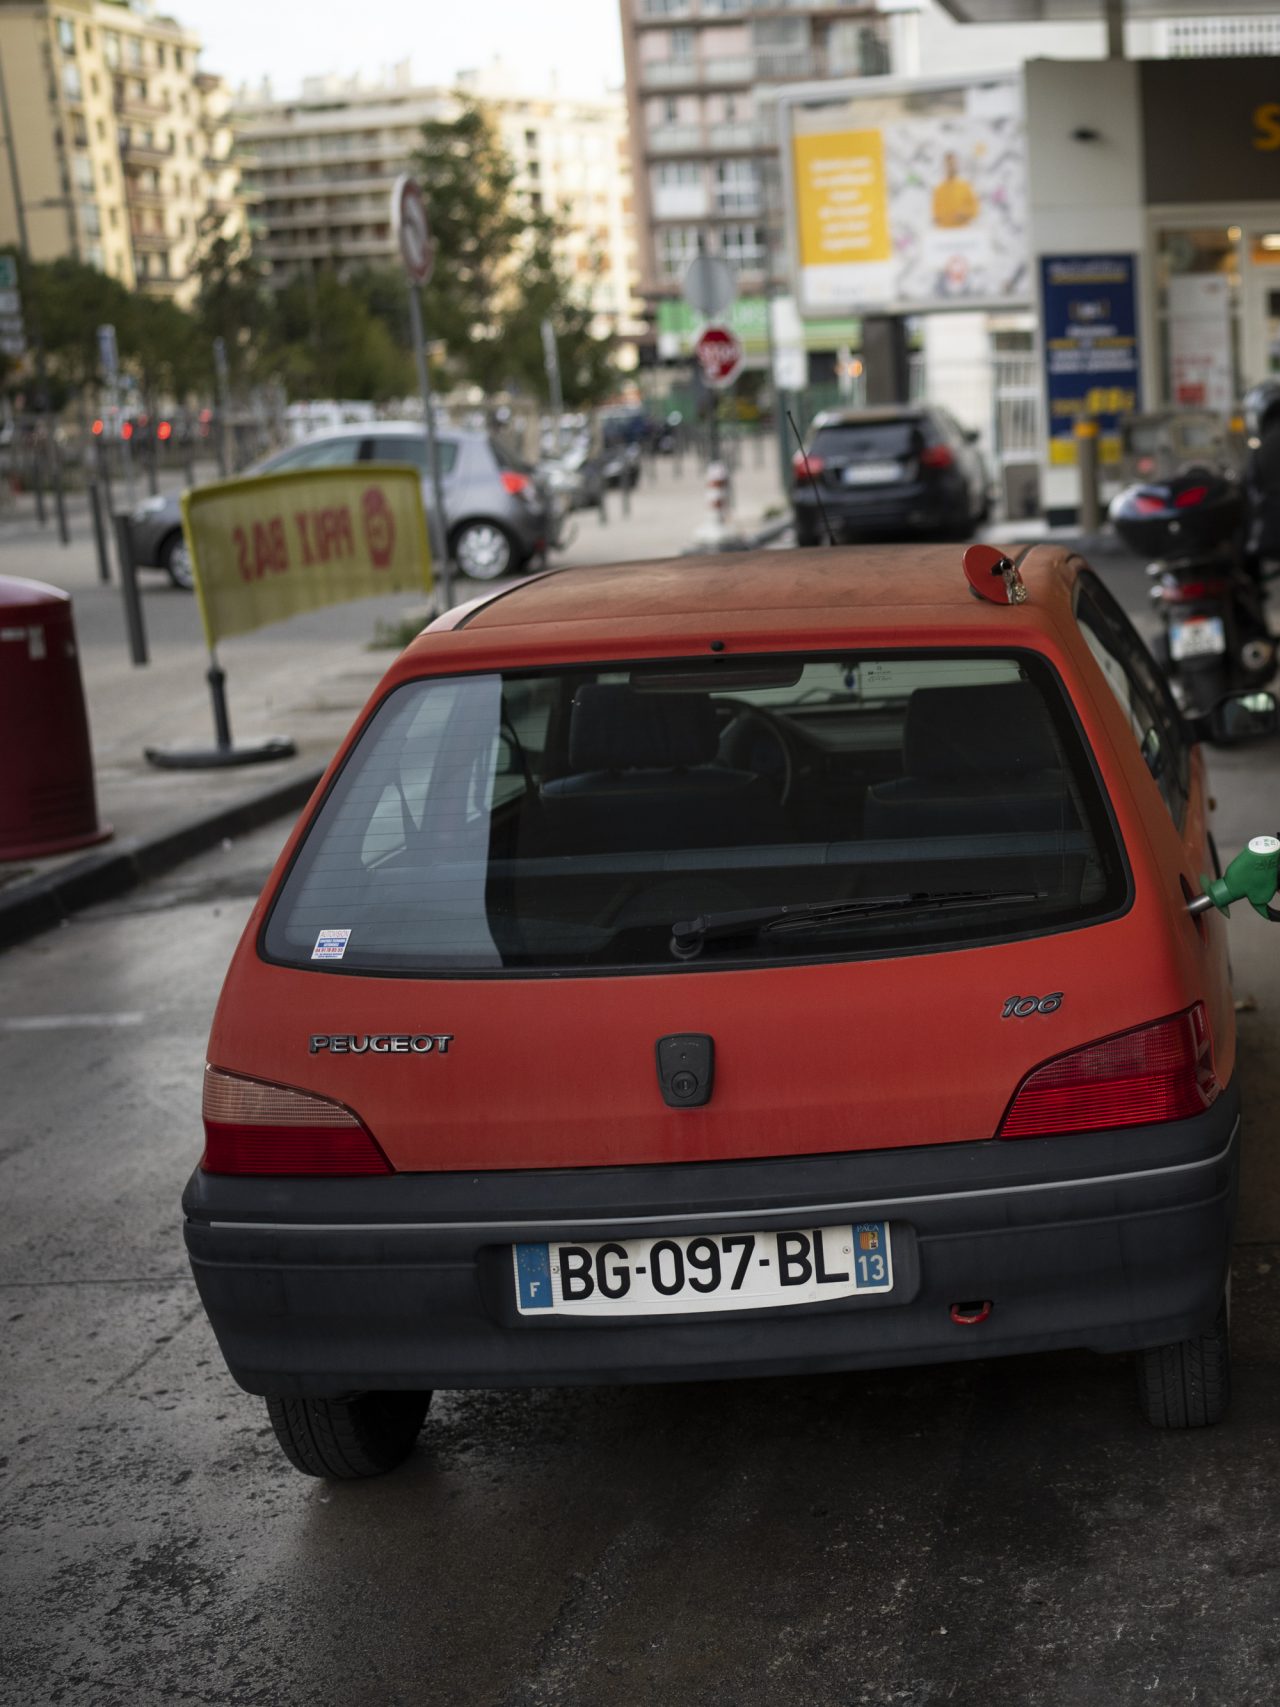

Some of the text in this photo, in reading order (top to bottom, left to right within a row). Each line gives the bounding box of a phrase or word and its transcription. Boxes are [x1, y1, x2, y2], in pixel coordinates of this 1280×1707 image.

[1002, 992, 1064, 1018] 106
[309, 1033, 454, 1054] PEUGEOT
[559, 1229, 849, 1301] BG-097-BL
[858, 1254, 885, 1282] 13
[529, 1281, 541, 1298] F
